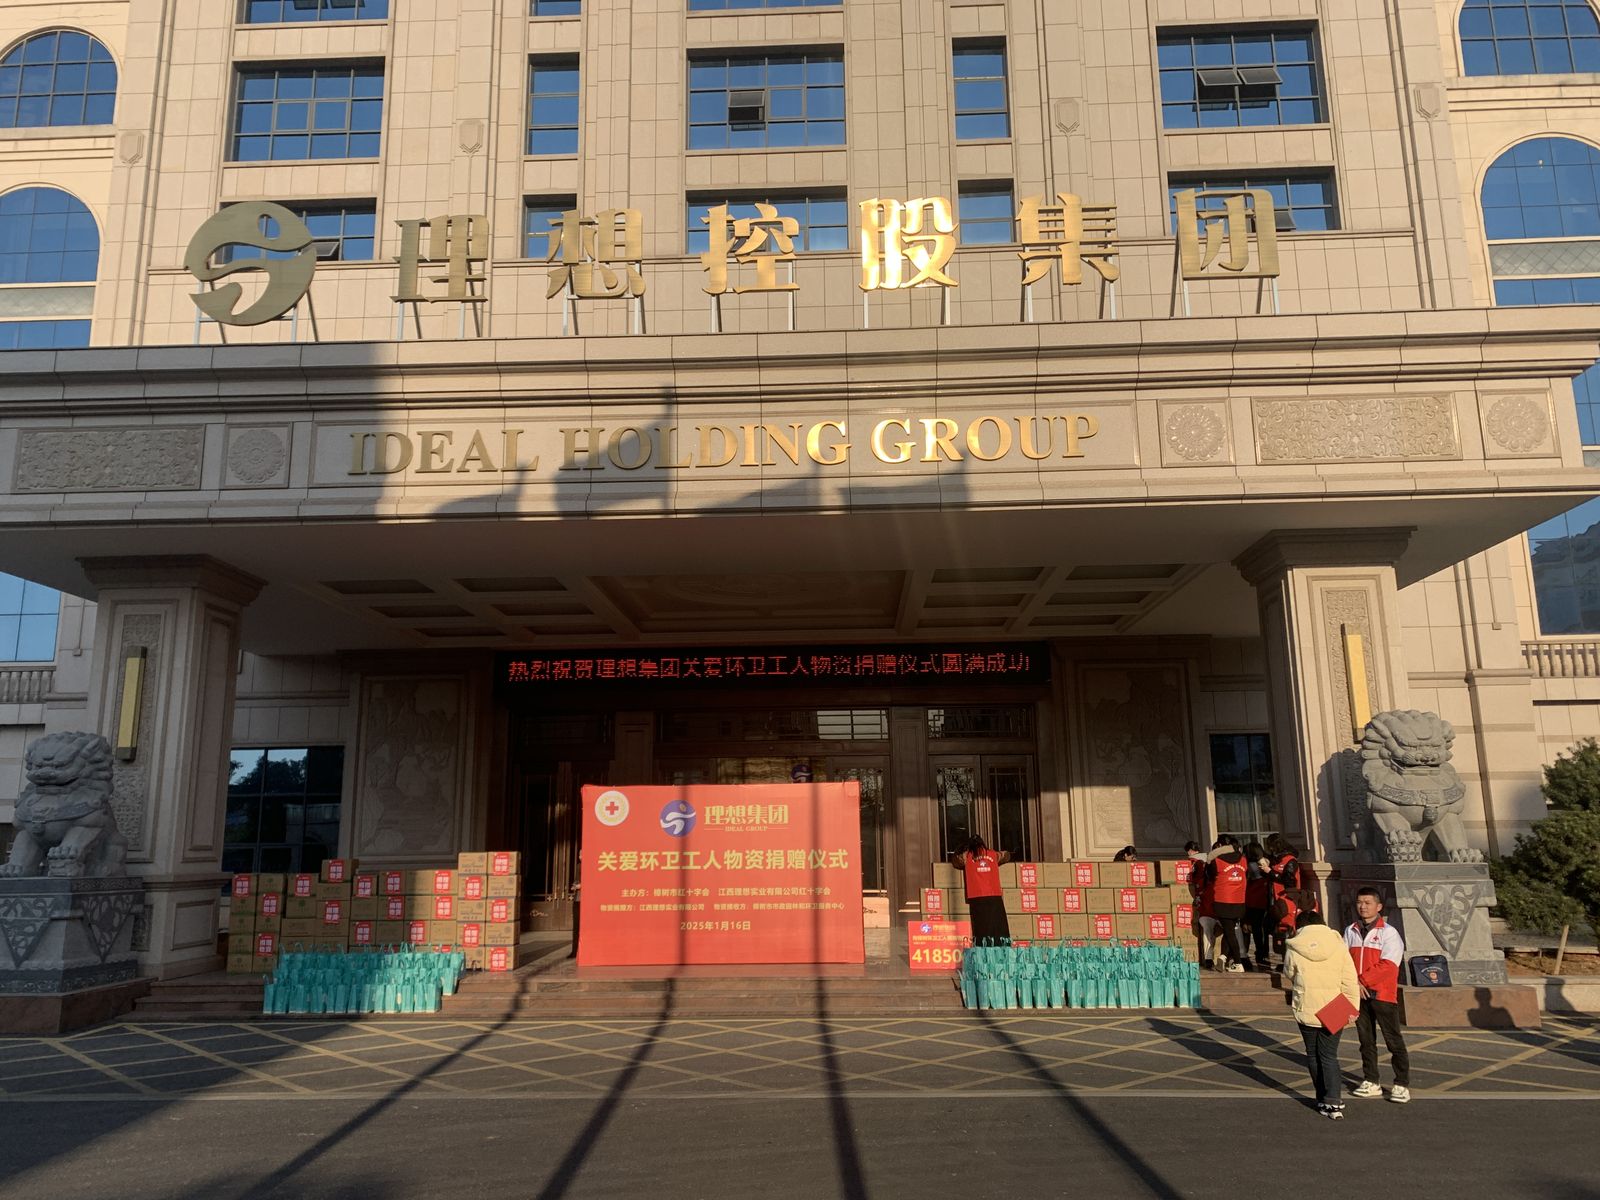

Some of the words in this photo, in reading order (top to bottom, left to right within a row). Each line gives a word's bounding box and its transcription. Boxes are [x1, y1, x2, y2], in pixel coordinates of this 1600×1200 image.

[389, 188, 1280, 303] 理想控股集团
[347, 429, 540, 475] IDEAL
[558, 419, 851, 472] HOLDING
[870, 414, 1099, 463] GROUP
[704, 804, 789, 825] 理想集团
[597, 848, 849, 871] 关爱环卫工人物资捐赠仪式
[680, 921, 751, 931] 2025年1月16日
[911, 948, 962, 964] 41850
